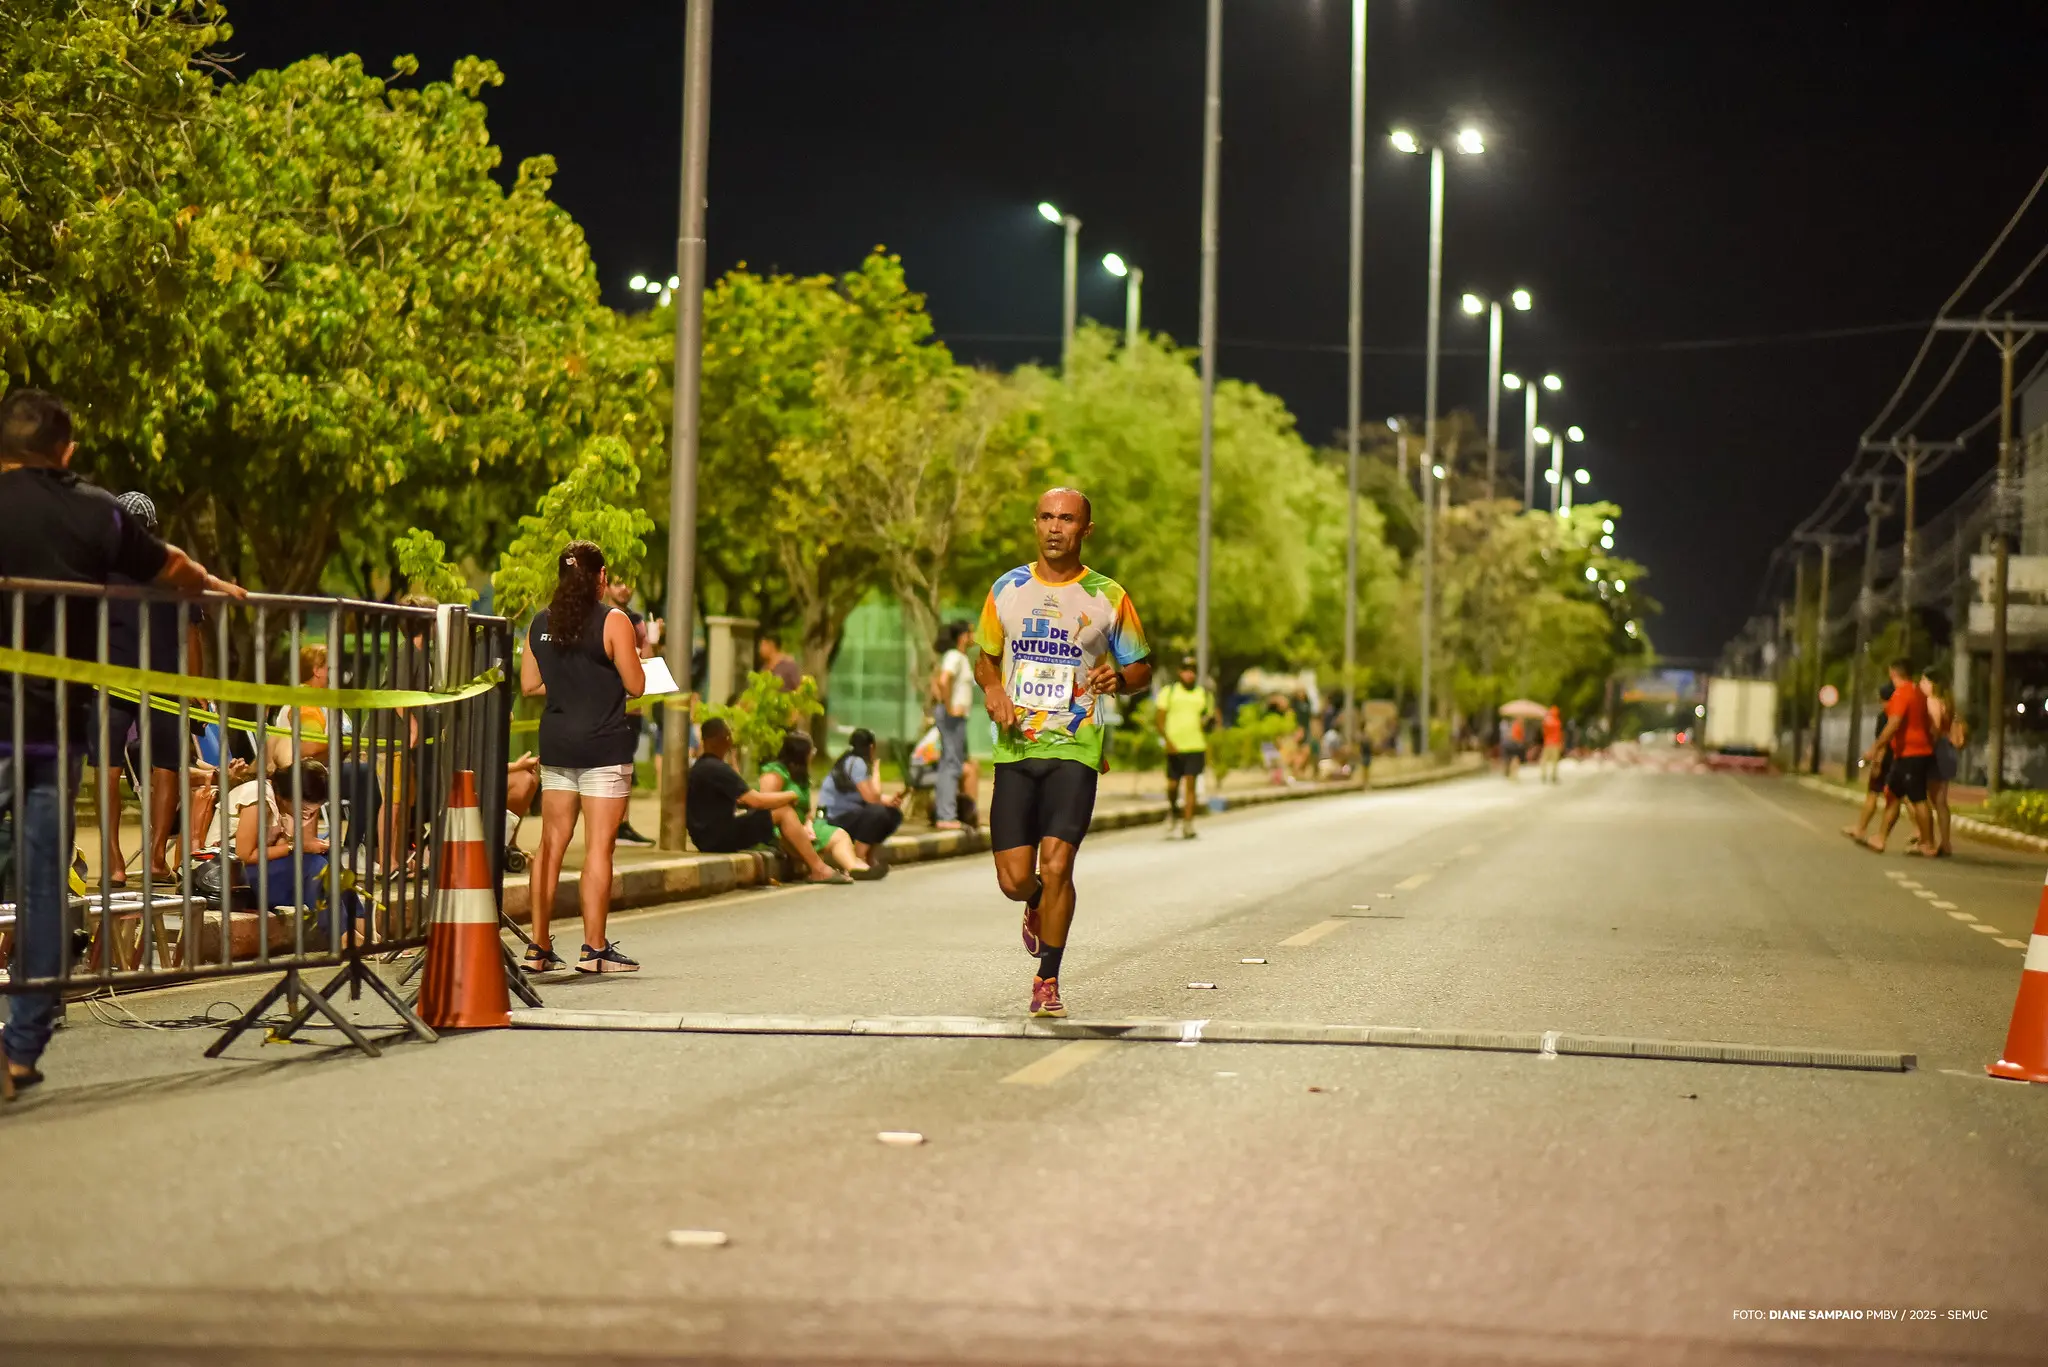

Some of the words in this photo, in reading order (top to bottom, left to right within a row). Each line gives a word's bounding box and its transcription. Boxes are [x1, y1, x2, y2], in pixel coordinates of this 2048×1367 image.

[1022, 618, 1050, 638] 15
[1050, 627, 1069, 641] DE
[1011, 639, 1083, 658] OUTUBRO
